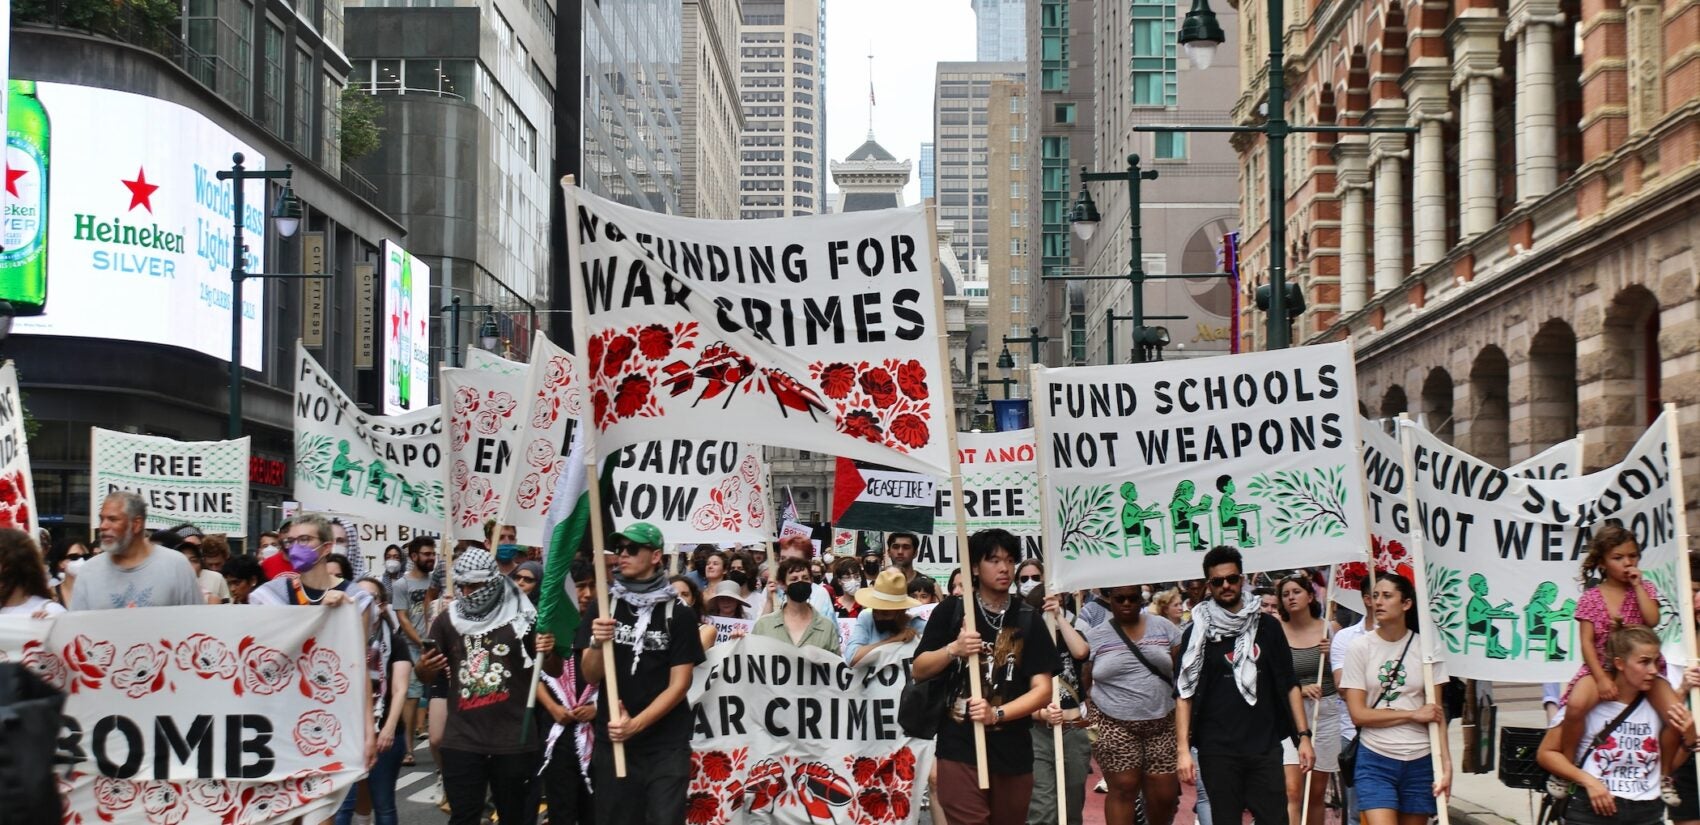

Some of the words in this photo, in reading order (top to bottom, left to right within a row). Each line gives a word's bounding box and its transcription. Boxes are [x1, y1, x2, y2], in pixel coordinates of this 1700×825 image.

[74, 213, 184, 254] Heineken
[578, 205, 627, 245] NO
[828, 234, 918, 281] FOR
[93, 250, 175, 279] SILVER
[363, 275, 371, 303] CITY
[311, 280, 321, 336] FITNESS
[580, 255, 693, 315] WAR
[713, 288, 926, 347] CRIMES
[362, 306, 371, 357] FITNESS
[1049, 382, 1137, 419] FUND
[1154, 364, 1339, 415] SCHOOLS
[134, 452, 203, 477] FREE
[1053, 431, 1118, 468] NOT
[1136, 412, 1343, 465] WEAPONS
[1415, 444, 1509, 501] FUND
[935, 488, 1025, 517] FREE
[1416, 498, 1474, 552] NOT
[54, 713, 276, 779] BOMB
[1619, 737, 1641, 751] FOR
[1626, 752, 1633, 764] A
[1613, 766, 1641, 779] FREE
